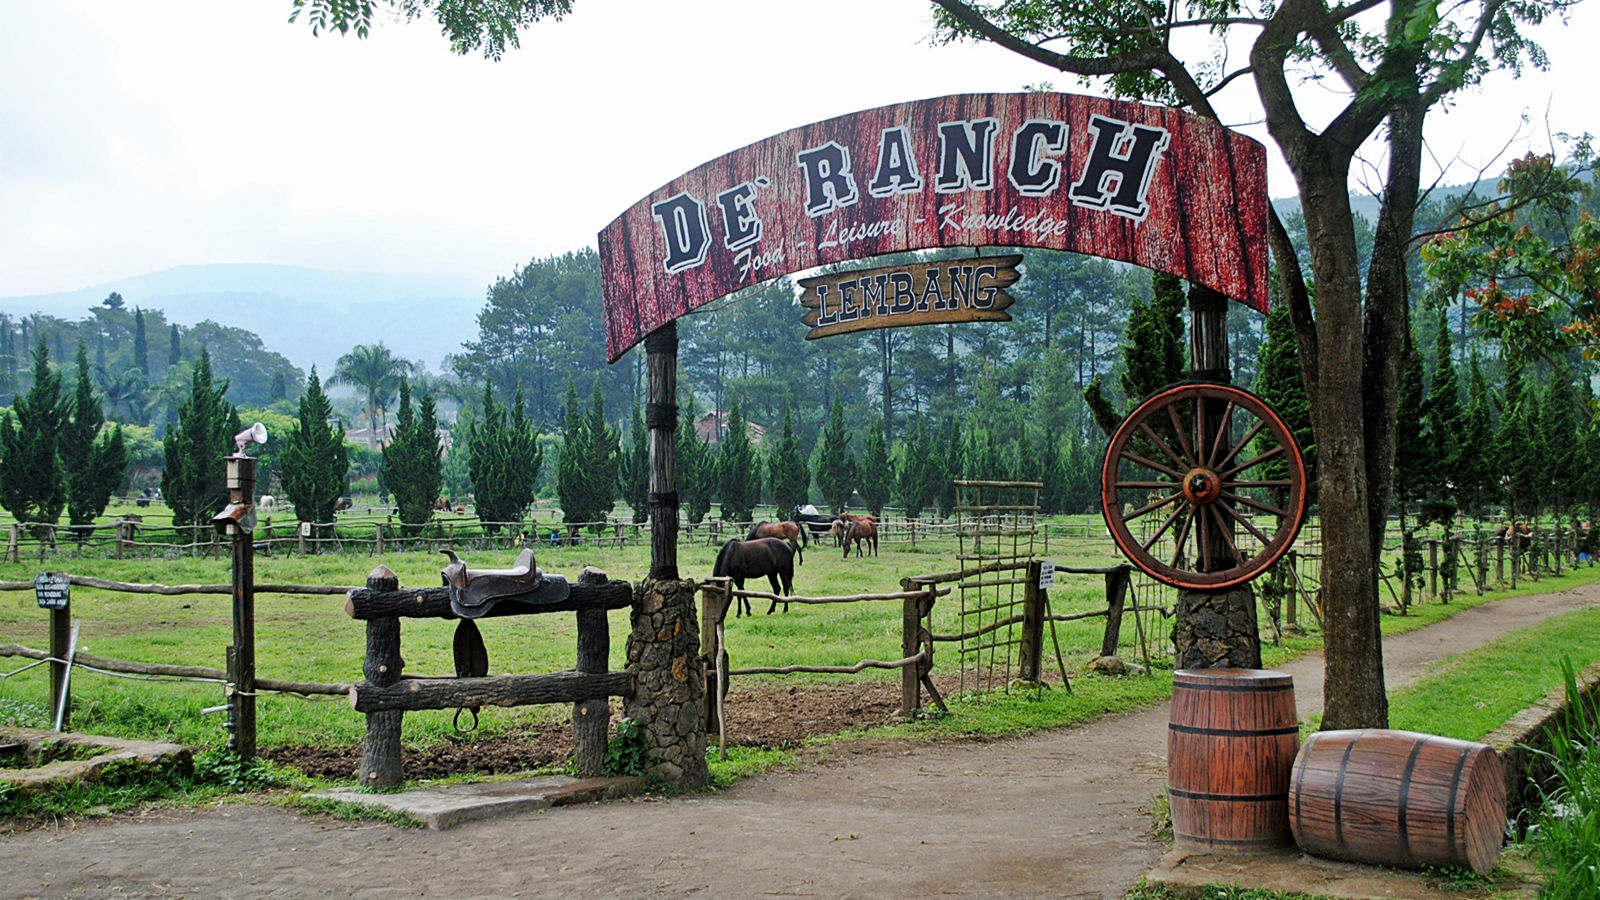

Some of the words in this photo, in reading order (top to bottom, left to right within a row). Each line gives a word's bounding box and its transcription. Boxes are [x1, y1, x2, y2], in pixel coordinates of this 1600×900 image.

[796, 114, 1169, 222] RANCH
[733, 238, 786, 283] Food
[817, 218, 904, 251] Leisure
[938, 202, 1068, 243] Knowledge
[816, 265, 999, 327] LEMBANG
